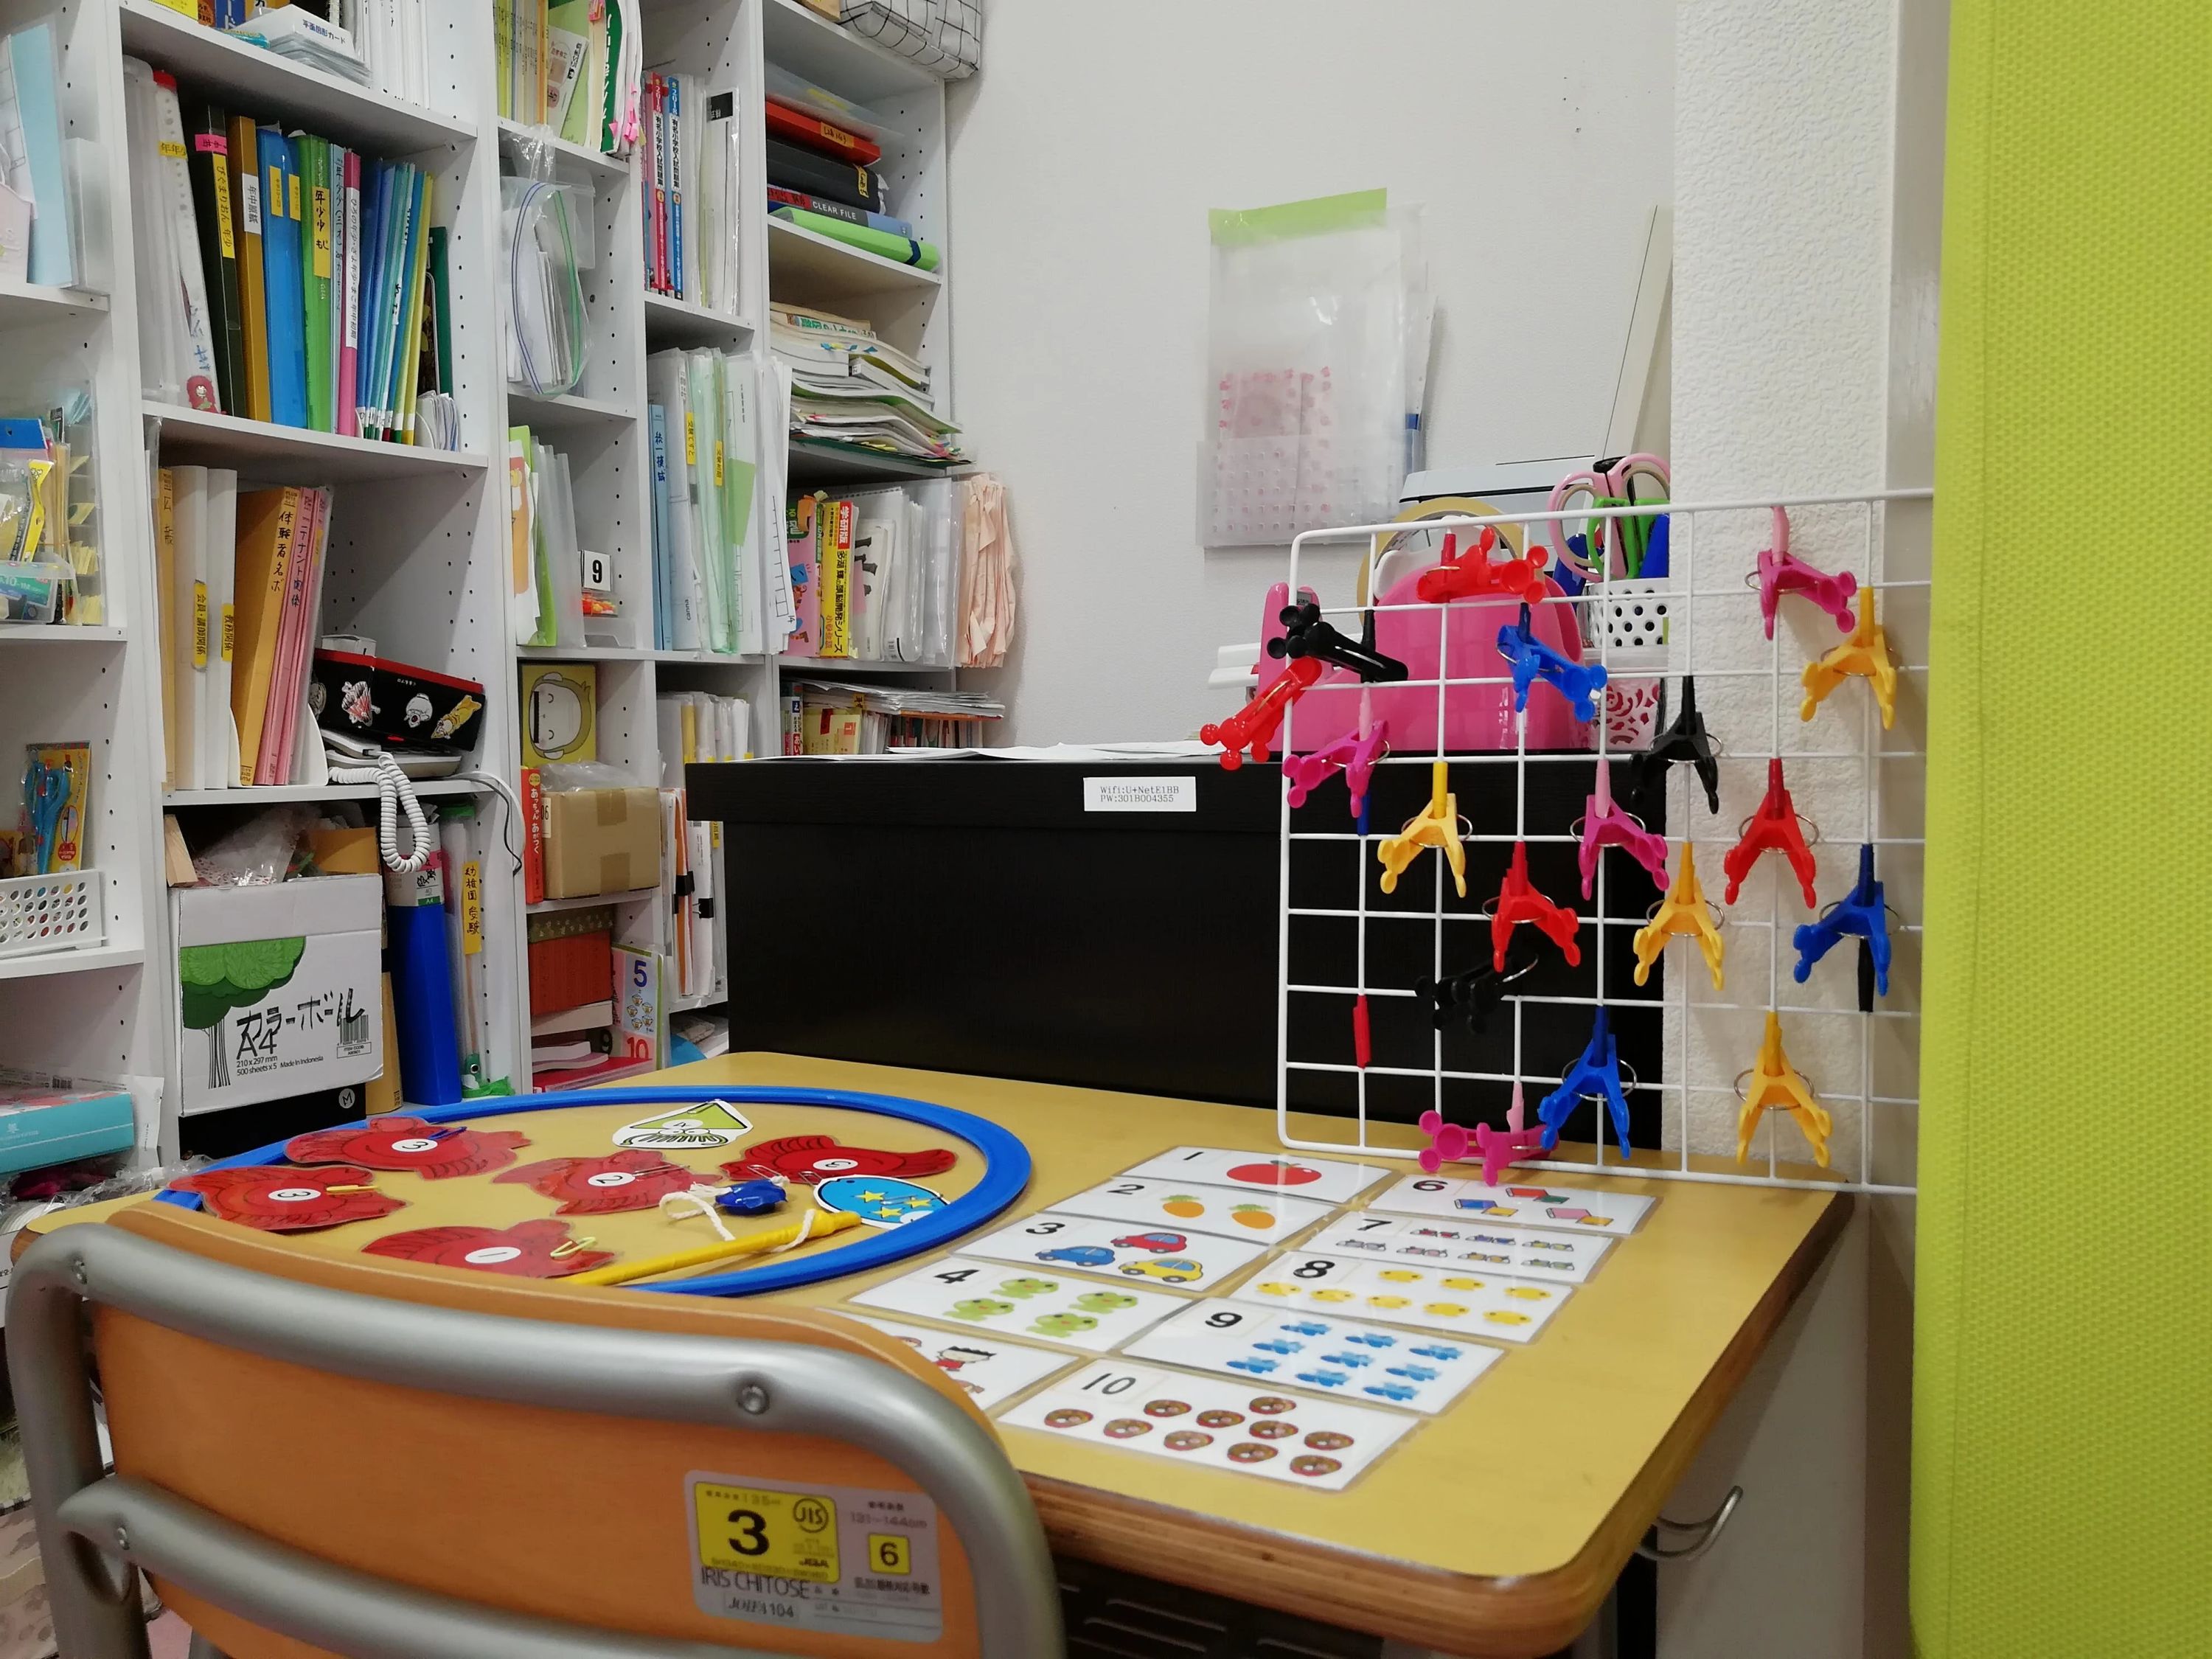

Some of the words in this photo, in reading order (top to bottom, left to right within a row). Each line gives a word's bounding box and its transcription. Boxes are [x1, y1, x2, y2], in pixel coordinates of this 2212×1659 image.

[813, 200, 839, 215] CLEAR
[840, 208, 857, 220] FILE
[592, 560, 603, 583] 9
[633, 960, 648, 988] 5
[236, 987, 366, 1042] カラーボール
[236, 1028, 277, 1060] A4
[627, 1037, 649, 1059] 10
[236, 1058, 248, 1068] 210
[253, 1057, 265, 1066] 297
[265, 1055, 277, 1063] mm
[300, 1055, 324, 1065] Indonesia
[236, 1068, 248, 1077] 500
[248, 1065, 268, 1074] sheets
[1183, 1151, 1205, 1161] 1
[1107, 1183, 1146, 1195] 2
[1413, 1180, 1449, 1192] 6
[1025, 1222, 1066, 1235] 3
[1357, 1218, 1393, 1231] 7
[933, 1267, 981, 1284] 4
[1293, 1260, 1335, 1279] 8
[1204, 1312, 1243, 1328] 9
[1082, 1372, 1136, 1396] 10
[727, 1509, 771, 1556] 3
[879, 1542, 900, 1567] 6
[735, 1572, 810, 1600] CHITOSE
